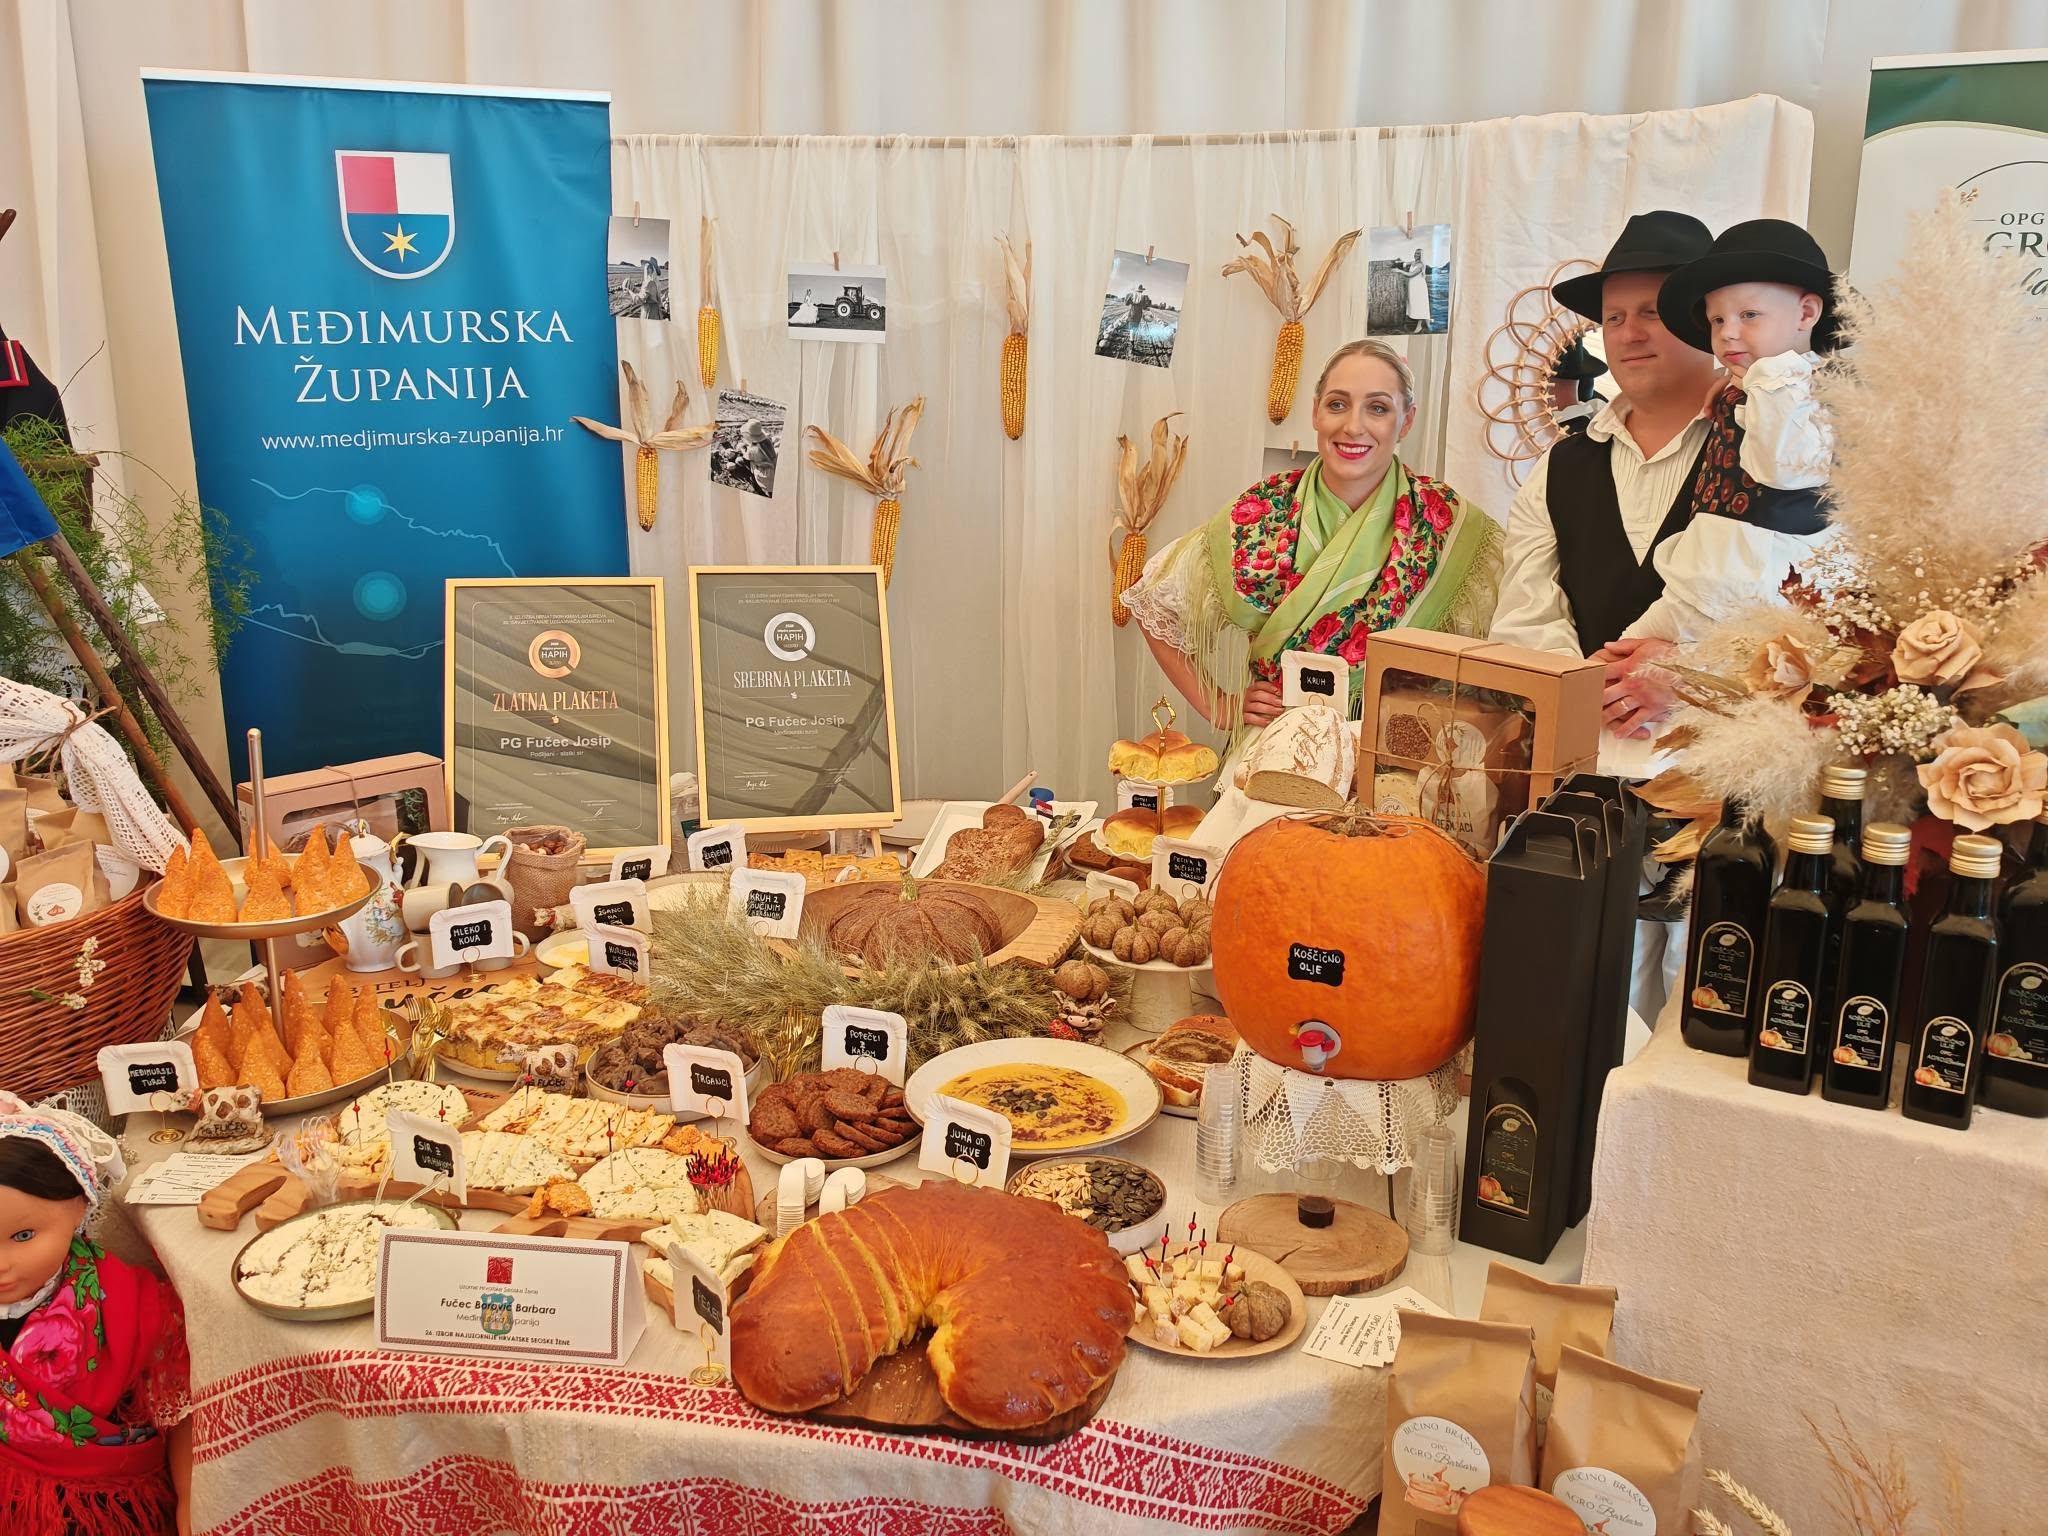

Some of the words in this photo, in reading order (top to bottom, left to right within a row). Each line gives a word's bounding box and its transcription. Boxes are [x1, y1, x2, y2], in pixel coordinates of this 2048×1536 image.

[2000, 212, 2046, 226] OPG
[1983, 231, 2048, 258] GR
[233, 305, 573, 346] MEĐIMURSKA
[294, 355, 529, 408] ŽUPANIJA
[261, 426, 565, 452] www.medjimurska-zupanija.hr
[776, 633, 804, 641] HAPIH
[541, 650, 568, 659] HAPIH
[733, 670, 790, 689] SREBRNA
[794, 669, 851, 687] PLAKETA
[1306, 675, 1326, 687] KRUH
[493, 691, 548, 712] ZLATNA
[553, 690, 619, 710] PLAKETA
[745, 716, 765, 728] PG
[769, 715, 807, 728] Fučec
[810, 714, 845, 727] Josip
[501, 738, 522, 749] PG
[526, 736, 569, 749] Fučec
[573, 735, 611, 748] Josip
[624, 863, 647, 873] SLATKI
[750, 892, 772, 903] KRUH
[453, 925, 480, 937] MLEKO
[458, 934, 481, 945] KOVA
[1293, 947, 1341, 964] KOŠČIČNO
[1299, 962, 1323, 975] OLJE
[141, 1076, 167, 1087] TUROŠ
[695, 1072, 729, 1088] TRGANCI
[949, 1128, 973, 1143] JUHA
[417, 1141, 432, 1153] SIR
[954, 1143, 981, 1158] TIKVE
[440, 1297, 471, 1309] Fučec
[474, 1299, 512, 1312] Borović
[515, 1303, 556, 1315] Barbara
[455, 1331, 497, 1340] NAJUZORNIJE
[499, 1335, 529, 1343] HRVATSKE
[531, 1337, 554, 1345] SEOSKE
[555, 1338, 571, 1346] ŽENE
[1403, 1421, 1439, 1434] BUČINO
[1404, 1446, 1432, 1460] AGRO
[1566, 1491, 1595, 1510] AGRO
